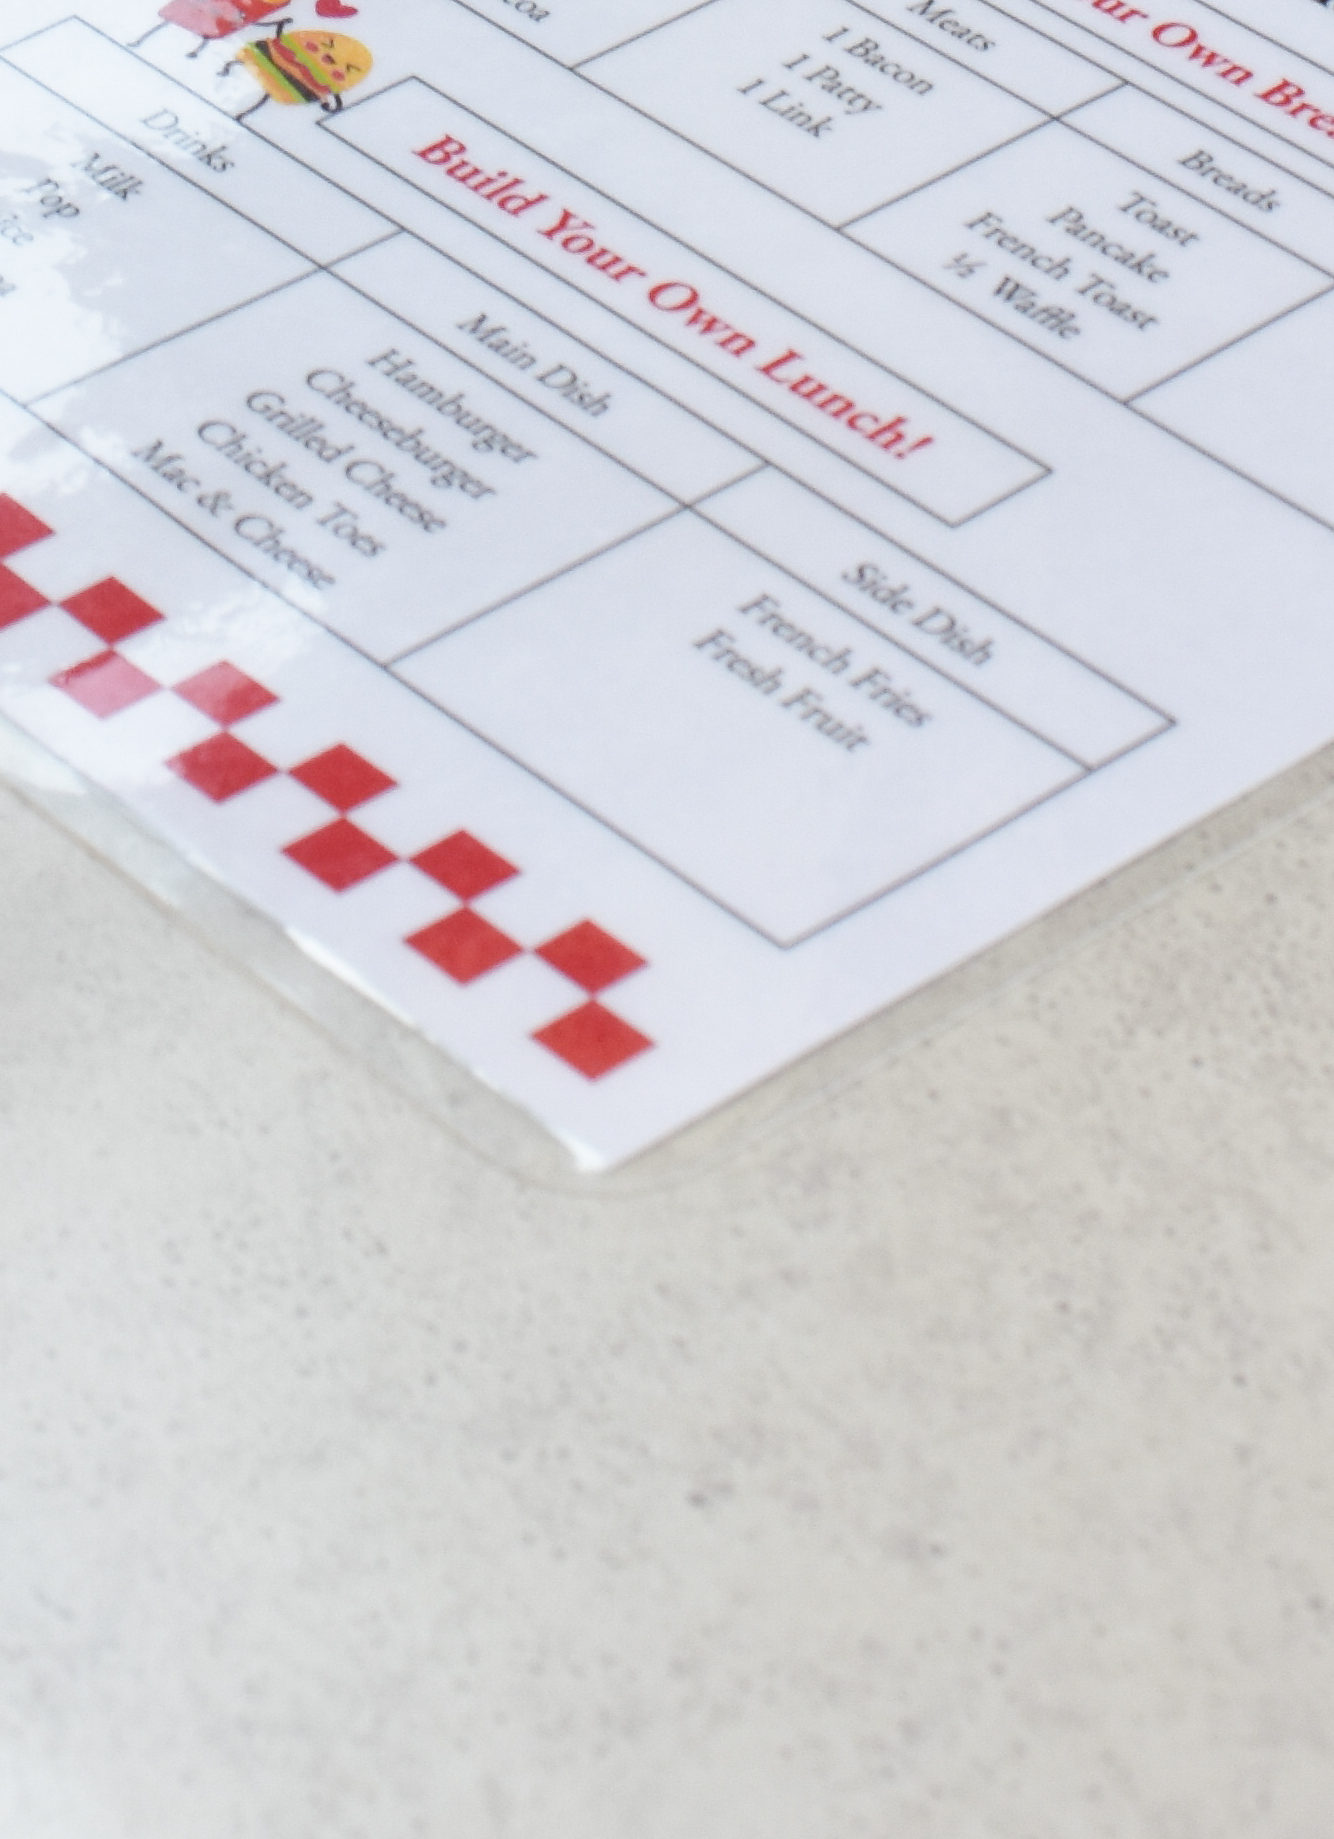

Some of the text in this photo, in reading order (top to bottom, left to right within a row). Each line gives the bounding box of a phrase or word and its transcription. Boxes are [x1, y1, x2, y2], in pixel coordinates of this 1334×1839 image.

[782, 53, 883, 116] 1 Patty
[823, 26, 935, 97] 1 Bacon
[1151, 20, 1254, 86] Own
[141, 107, 235, 175] Drinks
[737, 78, 833, 139] 1 Link
[23, 177, 81, 220] Pop
[71, 152, 145, 201] Milk
[1117, 191, 1202, 248] Toast
[1177, 148, 1282, 213] Breads
[964, 210, 1160, 332] French Toast
[1045, 205, 1170, 284] Pancake
[411, 134, 935, 460] Build Your Own Lunch!
[993, 274, 1082, 340] Waffle
[366, 347, 539, 464] Hamburger
[457, 312, 611, 419] Main Dish
[246, 389, 447, 533] Grilled Cheese
[305, 367, 496, 500] Cheeseburger
[131, 439, 336, 590] Mac & Cheese
[197, 419, 387, 558] Chicken Toes
[840, 560, 995, 667] Side Dish
[691, 627, 871, 753] Fresh Fruit
[737, 593, 933, 728] French Fries
